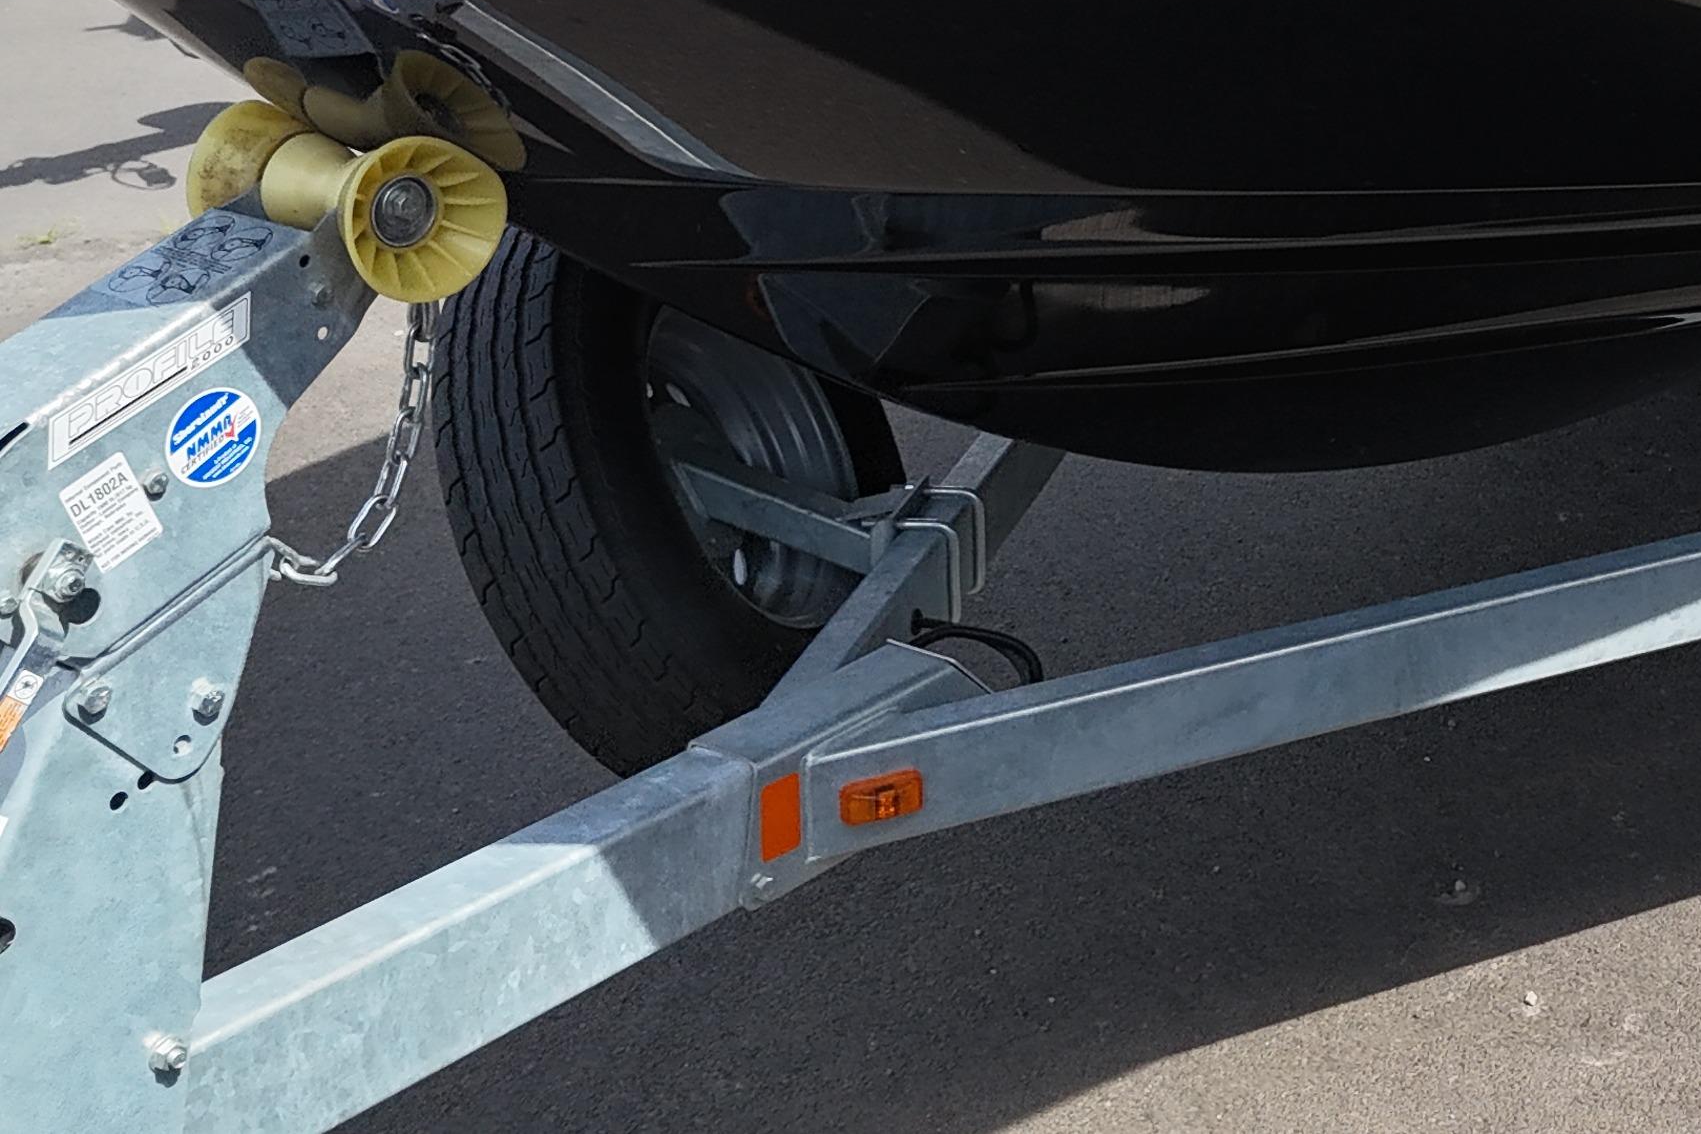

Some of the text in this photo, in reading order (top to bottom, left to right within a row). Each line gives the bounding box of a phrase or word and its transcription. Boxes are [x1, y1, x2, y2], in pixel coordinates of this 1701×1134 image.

[68, 309, 235, 439] PROFILE
[190, 335, 235, 371] 2000
[186, 413, 232, 460] NMMA
[69, 471, 129, 518] DL1802A
